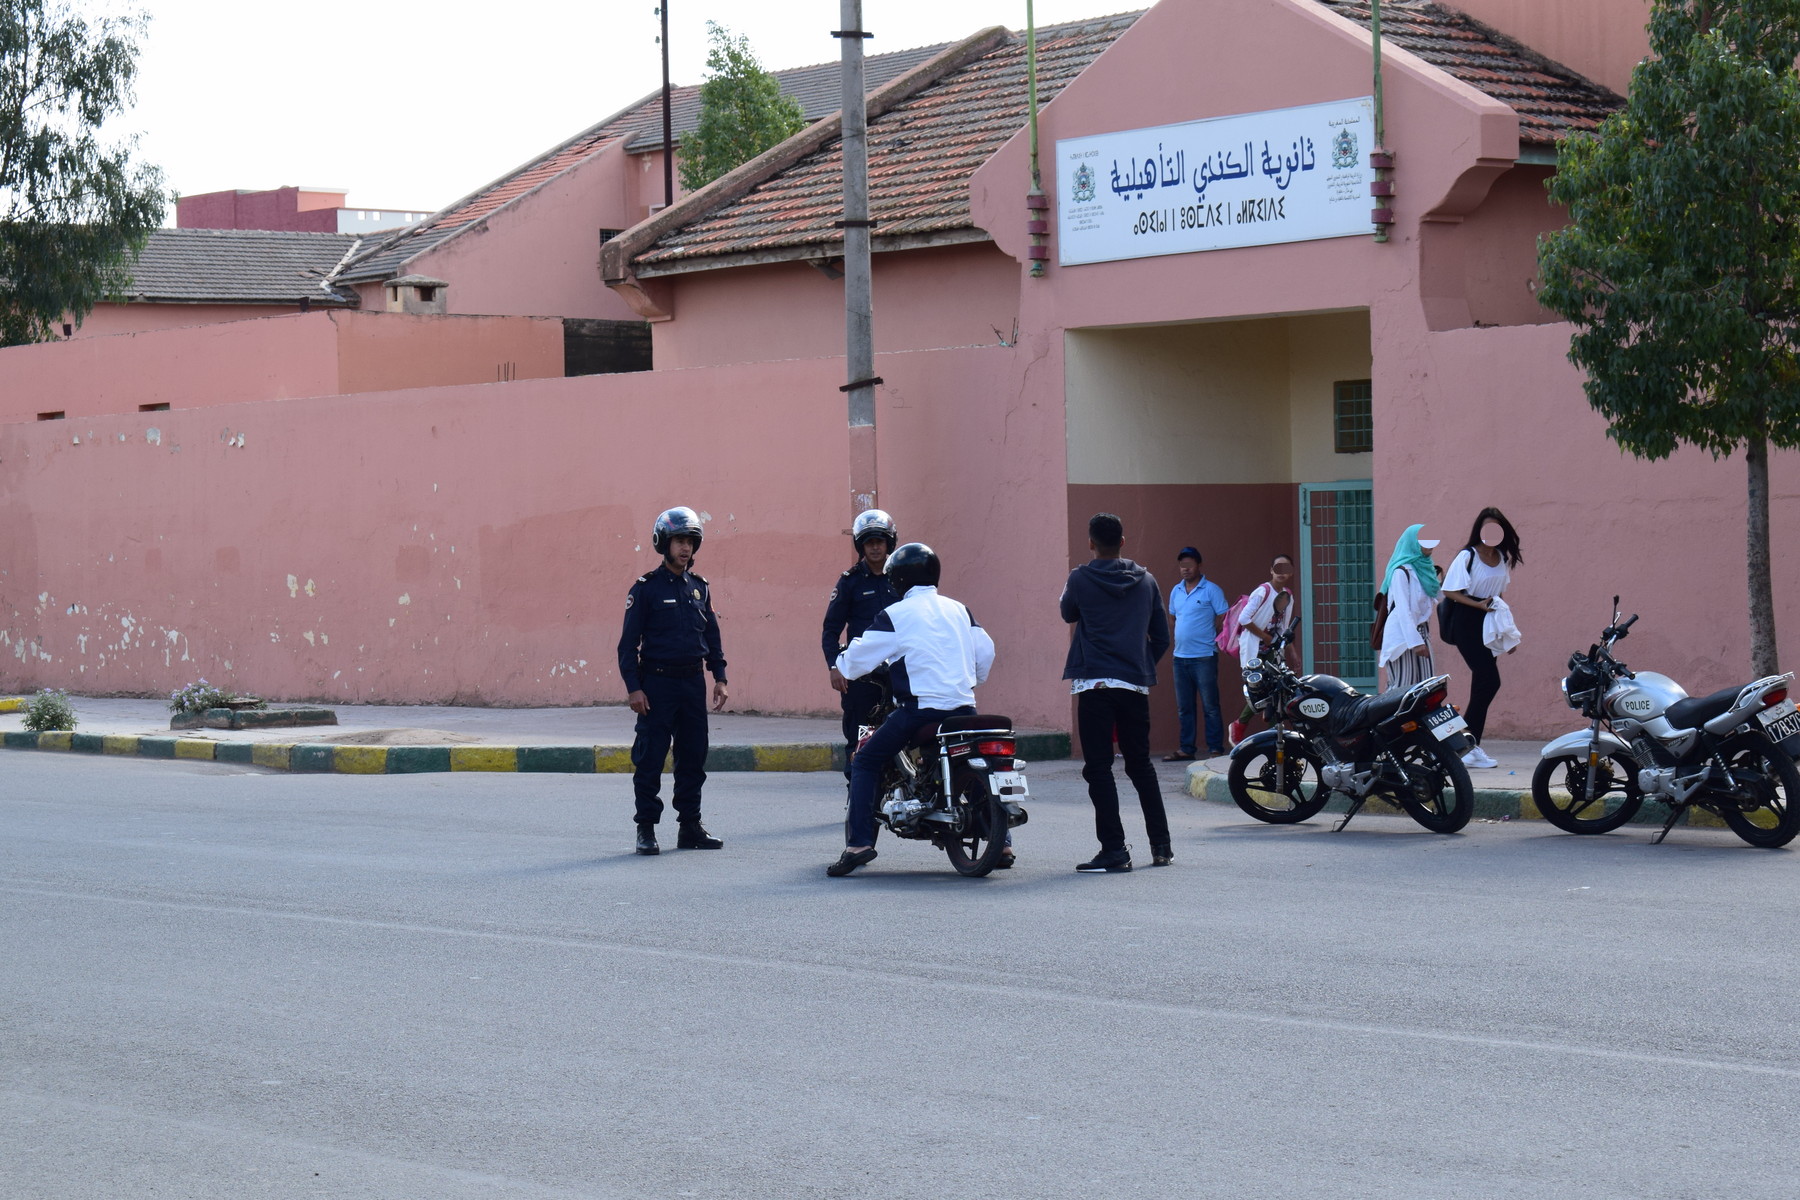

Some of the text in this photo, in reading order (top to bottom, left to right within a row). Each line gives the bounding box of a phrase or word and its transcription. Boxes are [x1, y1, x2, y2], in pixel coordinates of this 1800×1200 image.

[1110, 142, 1185, 202] التأهيلية
[1193, 141, 1254, 203] الكندي
[1261, 135, 1315, 190] ثانوية
[1302, 703, 1327, 714] POLICE
[1428, 708, 1455, 727] 184507
[1625, 700, 1651, 711] POLICE
